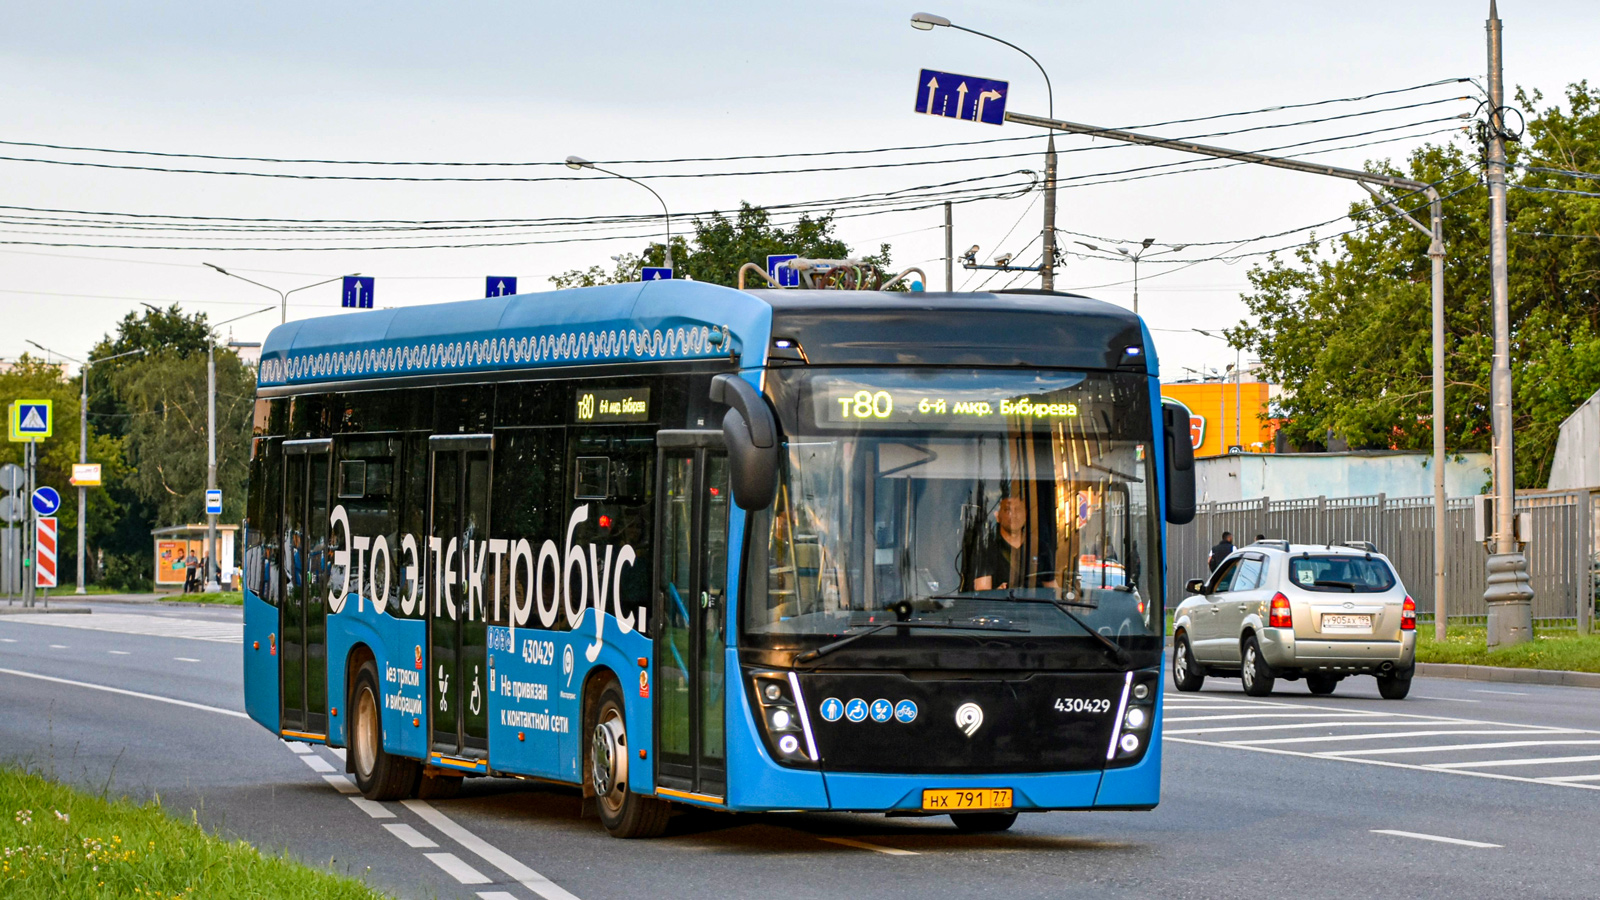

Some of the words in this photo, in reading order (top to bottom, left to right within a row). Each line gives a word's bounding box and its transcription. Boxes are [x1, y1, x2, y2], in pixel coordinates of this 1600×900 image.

[578, 394, 594, 419] т80
[838, 390, 893, 418] т80
[918, 398, 946, 414] 6-й
[953, 400, 993, 416] мкр.
[1000, 398, 1077, 418] Бибирева
[328, 504, 390, 614] Это
[522, 639, 554, 666] 430429
[397, 668, 420, 689] тряски
[501, 674, 512, 697] Не
[513, 681, 548, 703] привязан
[1054, 698, 1111, 713] 430429
[507, 708, 550, 731] контактной
[551, 715, 569, 734] сети
[956, 792, 982, 807] 791
[993, 791, 1007, 802] 77
